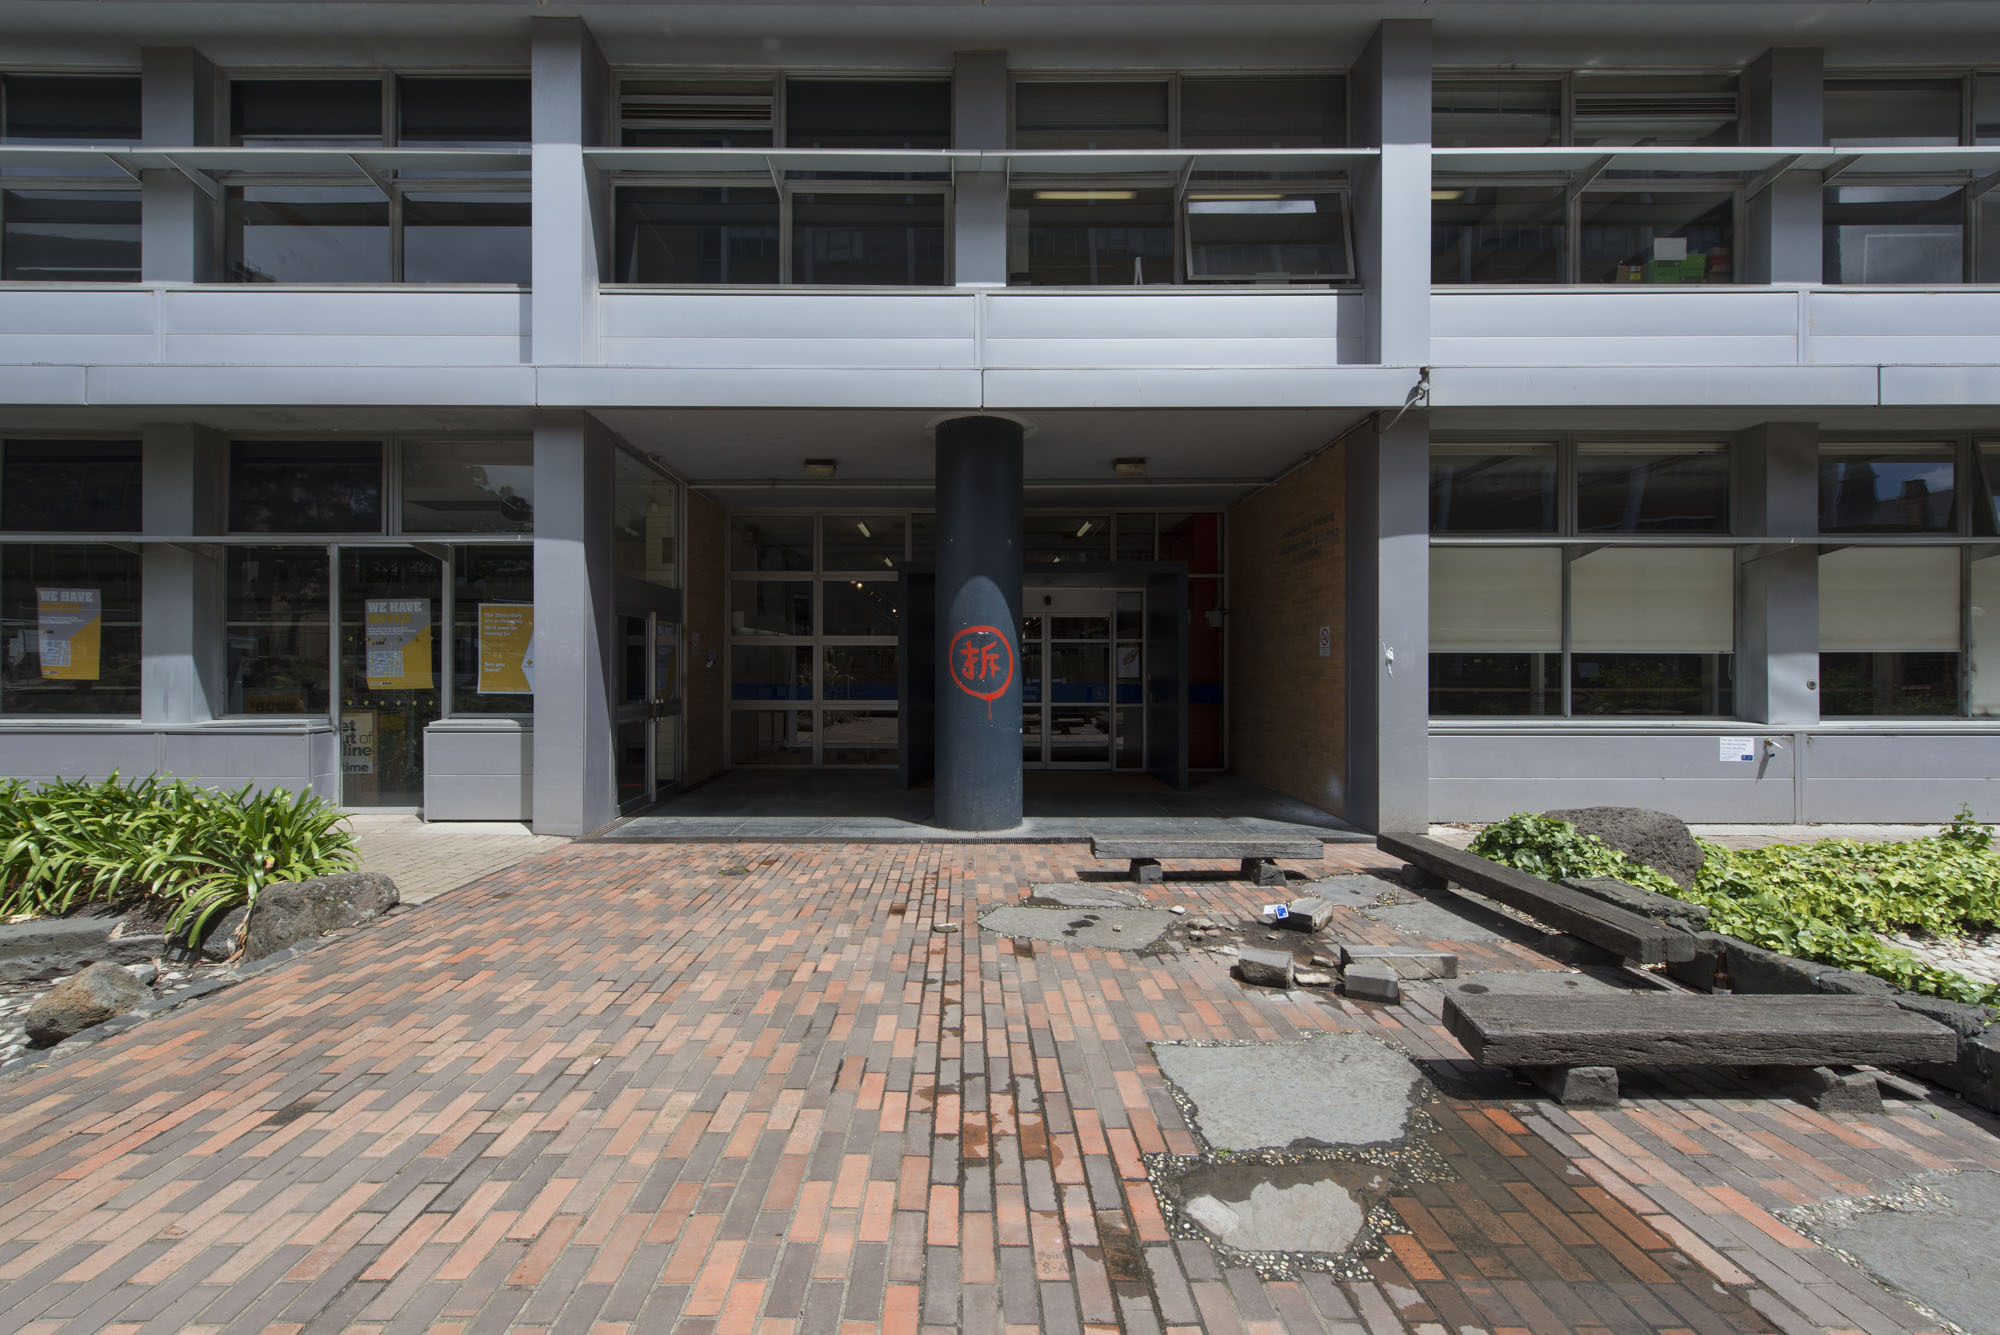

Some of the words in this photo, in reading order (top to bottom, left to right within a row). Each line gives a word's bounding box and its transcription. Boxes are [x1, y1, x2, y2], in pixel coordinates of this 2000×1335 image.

[40, 591, 58, 602] WE
[60, 591, 93, 602] HAVE
[368, 602, 387, 612] WE
[389, 602, 422, 612] HAVE
[960, 639, 1001, 680] 拆
[343, 720, 356, 732] et
[343, 732, 356, 744] ut
[360, 730, 374, 744] of
[343, 744, 372, 756] line
